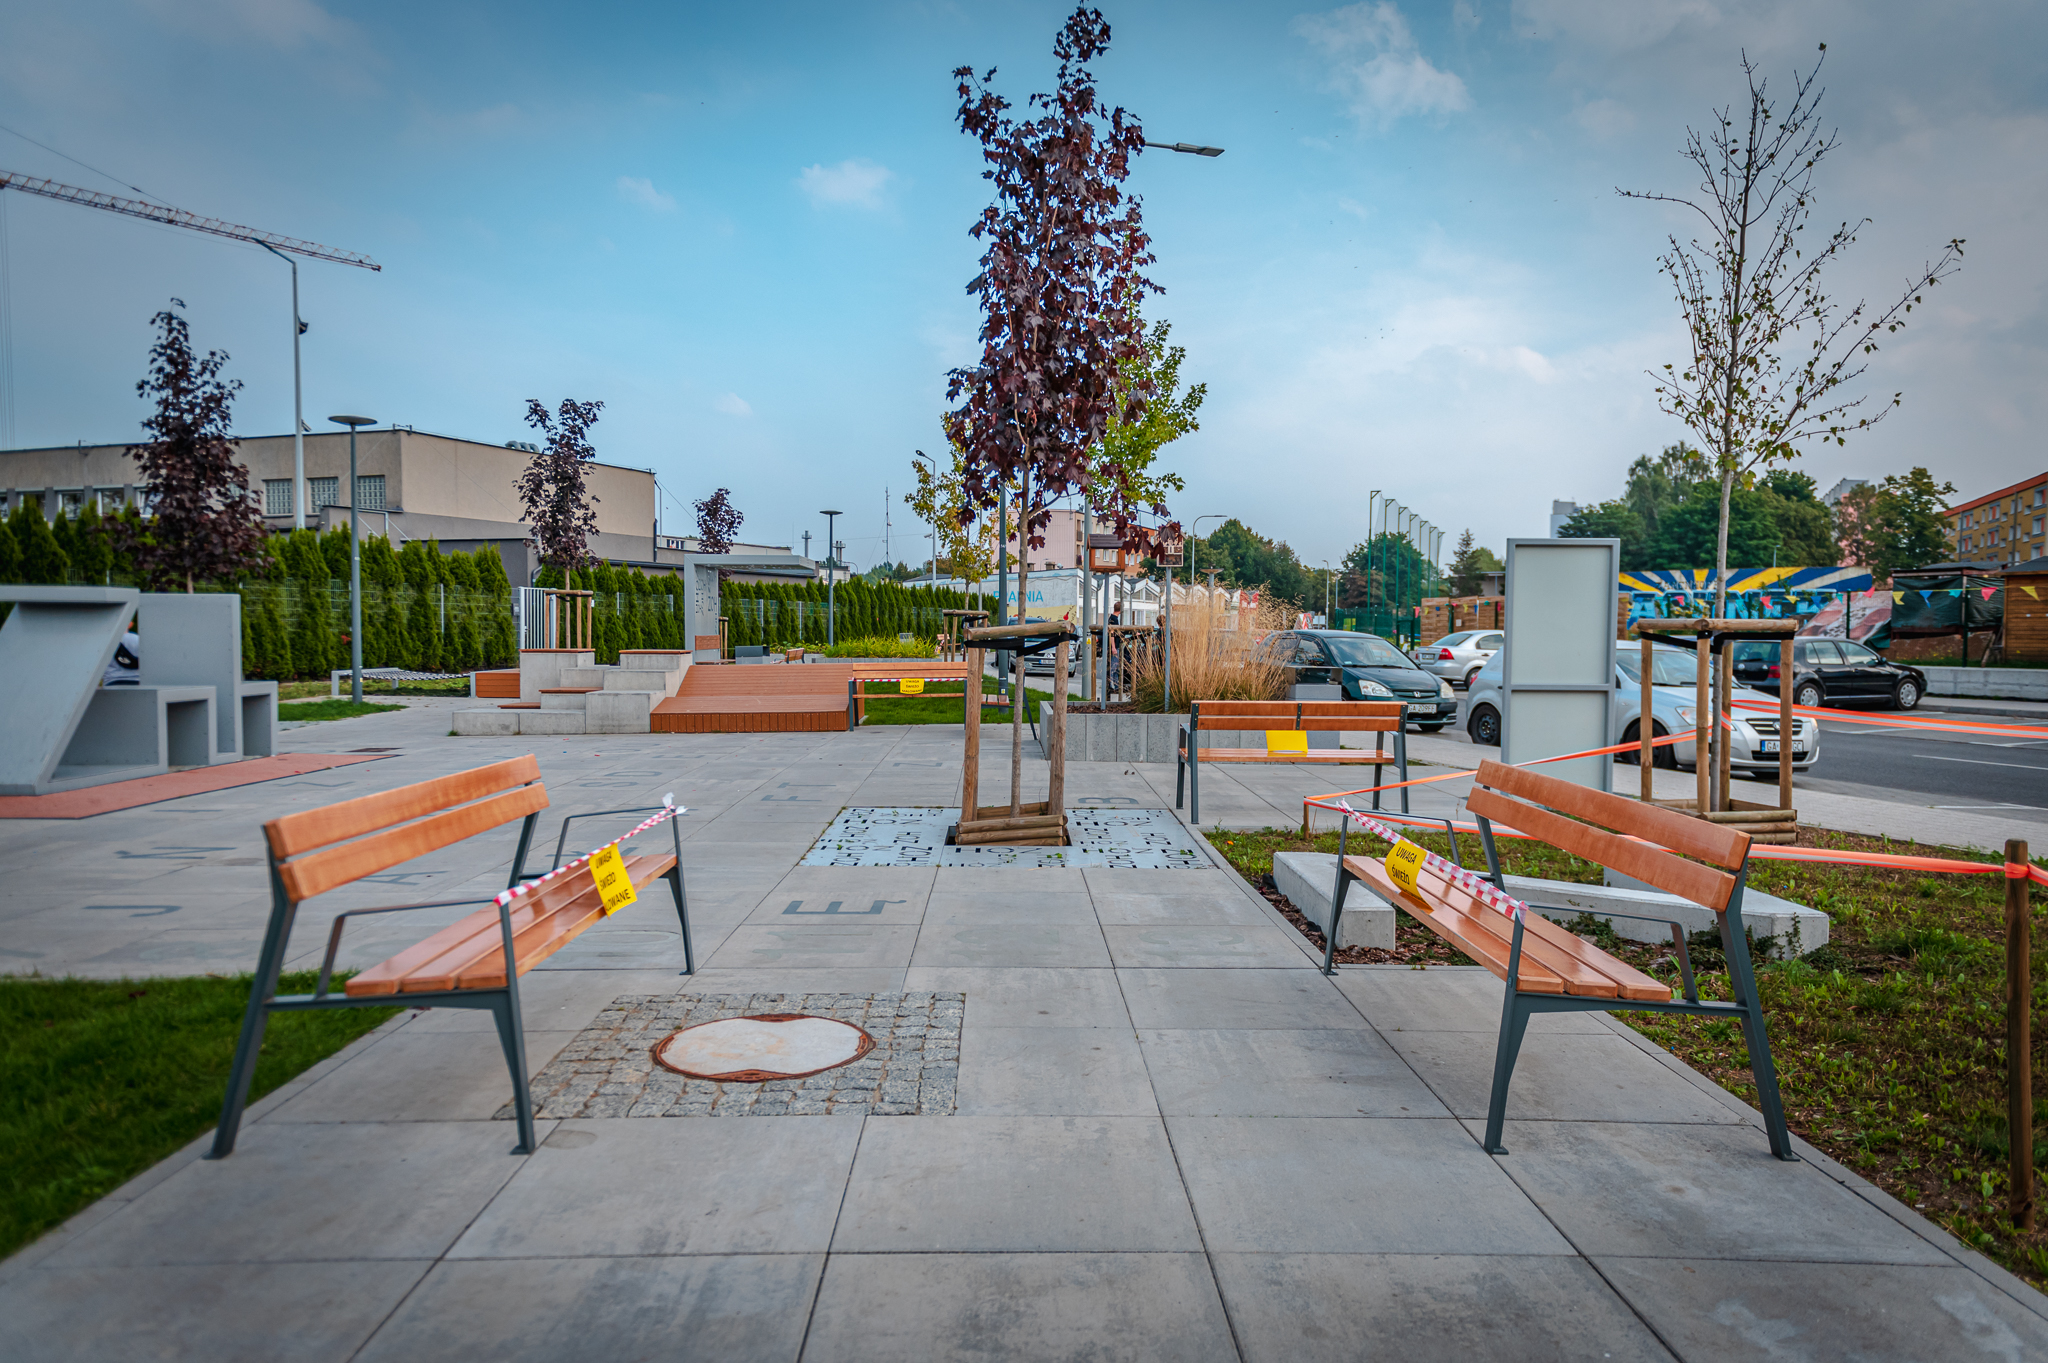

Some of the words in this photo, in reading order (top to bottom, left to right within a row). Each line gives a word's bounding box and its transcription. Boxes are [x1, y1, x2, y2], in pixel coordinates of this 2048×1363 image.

[993, 590, 1043, 602] PANIA
[595, 851, 613, 869] UWAGA
[1396, 847, 1418, 865] UWAGA
